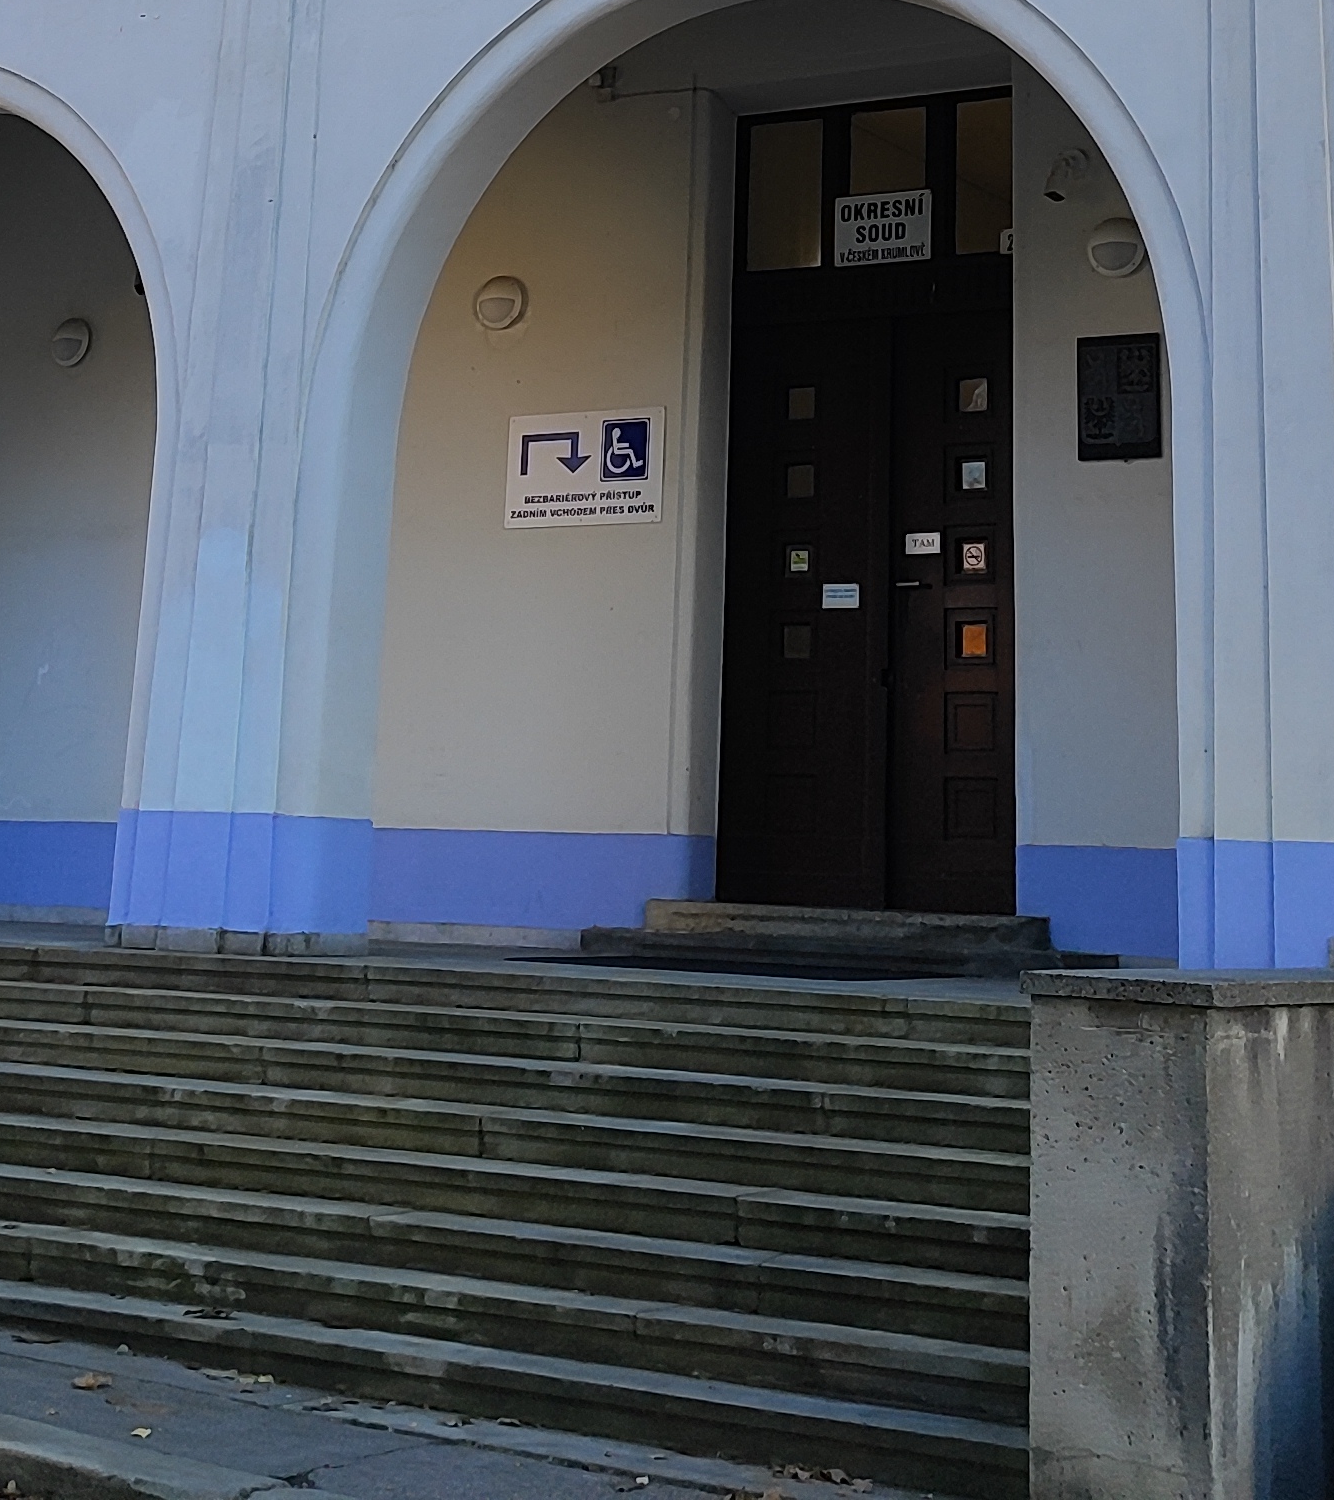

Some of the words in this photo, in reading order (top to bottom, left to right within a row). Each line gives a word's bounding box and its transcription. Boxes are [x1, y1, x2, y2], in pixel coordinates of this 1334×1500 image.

[840, 193, 926, 223] OKRESNÍ
[855, 222, 907, 244] SOUD
[839, 252, 846, 263] V
[510, 508, 547, 519] ZADNÍM
[550, 506, 597, 517] VCHODEM
[911, 538, 935, 548] TAM
